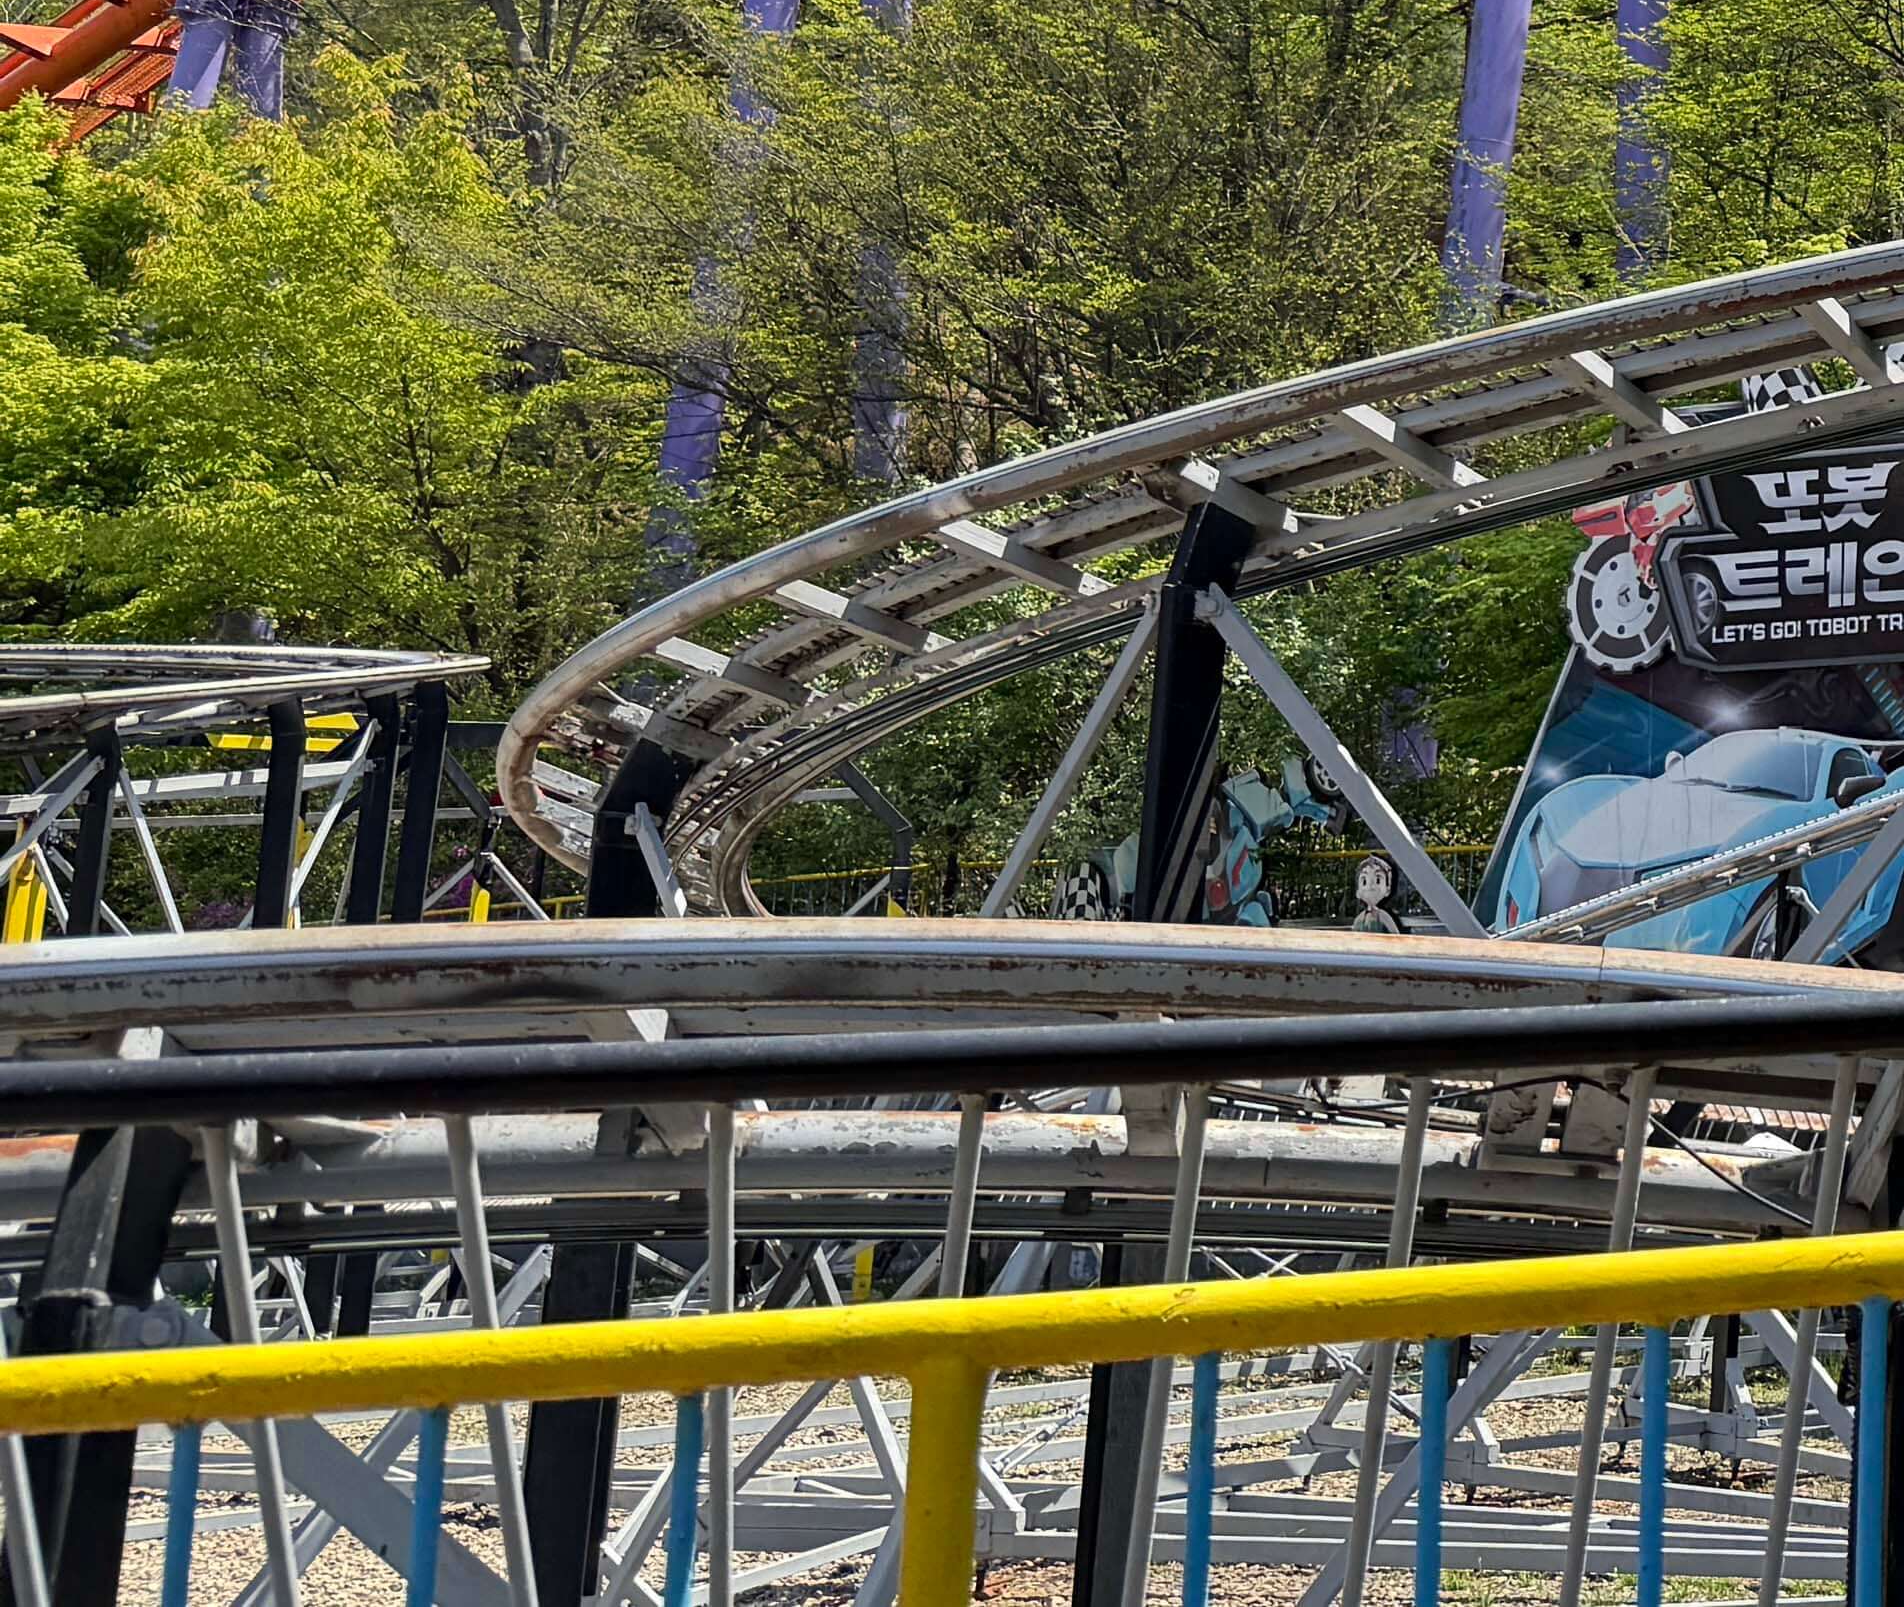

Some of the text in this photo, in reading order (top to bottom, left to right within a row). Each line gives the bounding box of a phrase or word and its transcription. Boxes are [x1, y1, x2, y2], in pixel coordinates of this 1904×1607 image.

[1742, 461, 1901, 535] 또봇
[1712, 623, 1766, 644] LET'S
[1769, 620, 1802, 640] GO!
[1806, 615, 1872, 637] TOBOT
